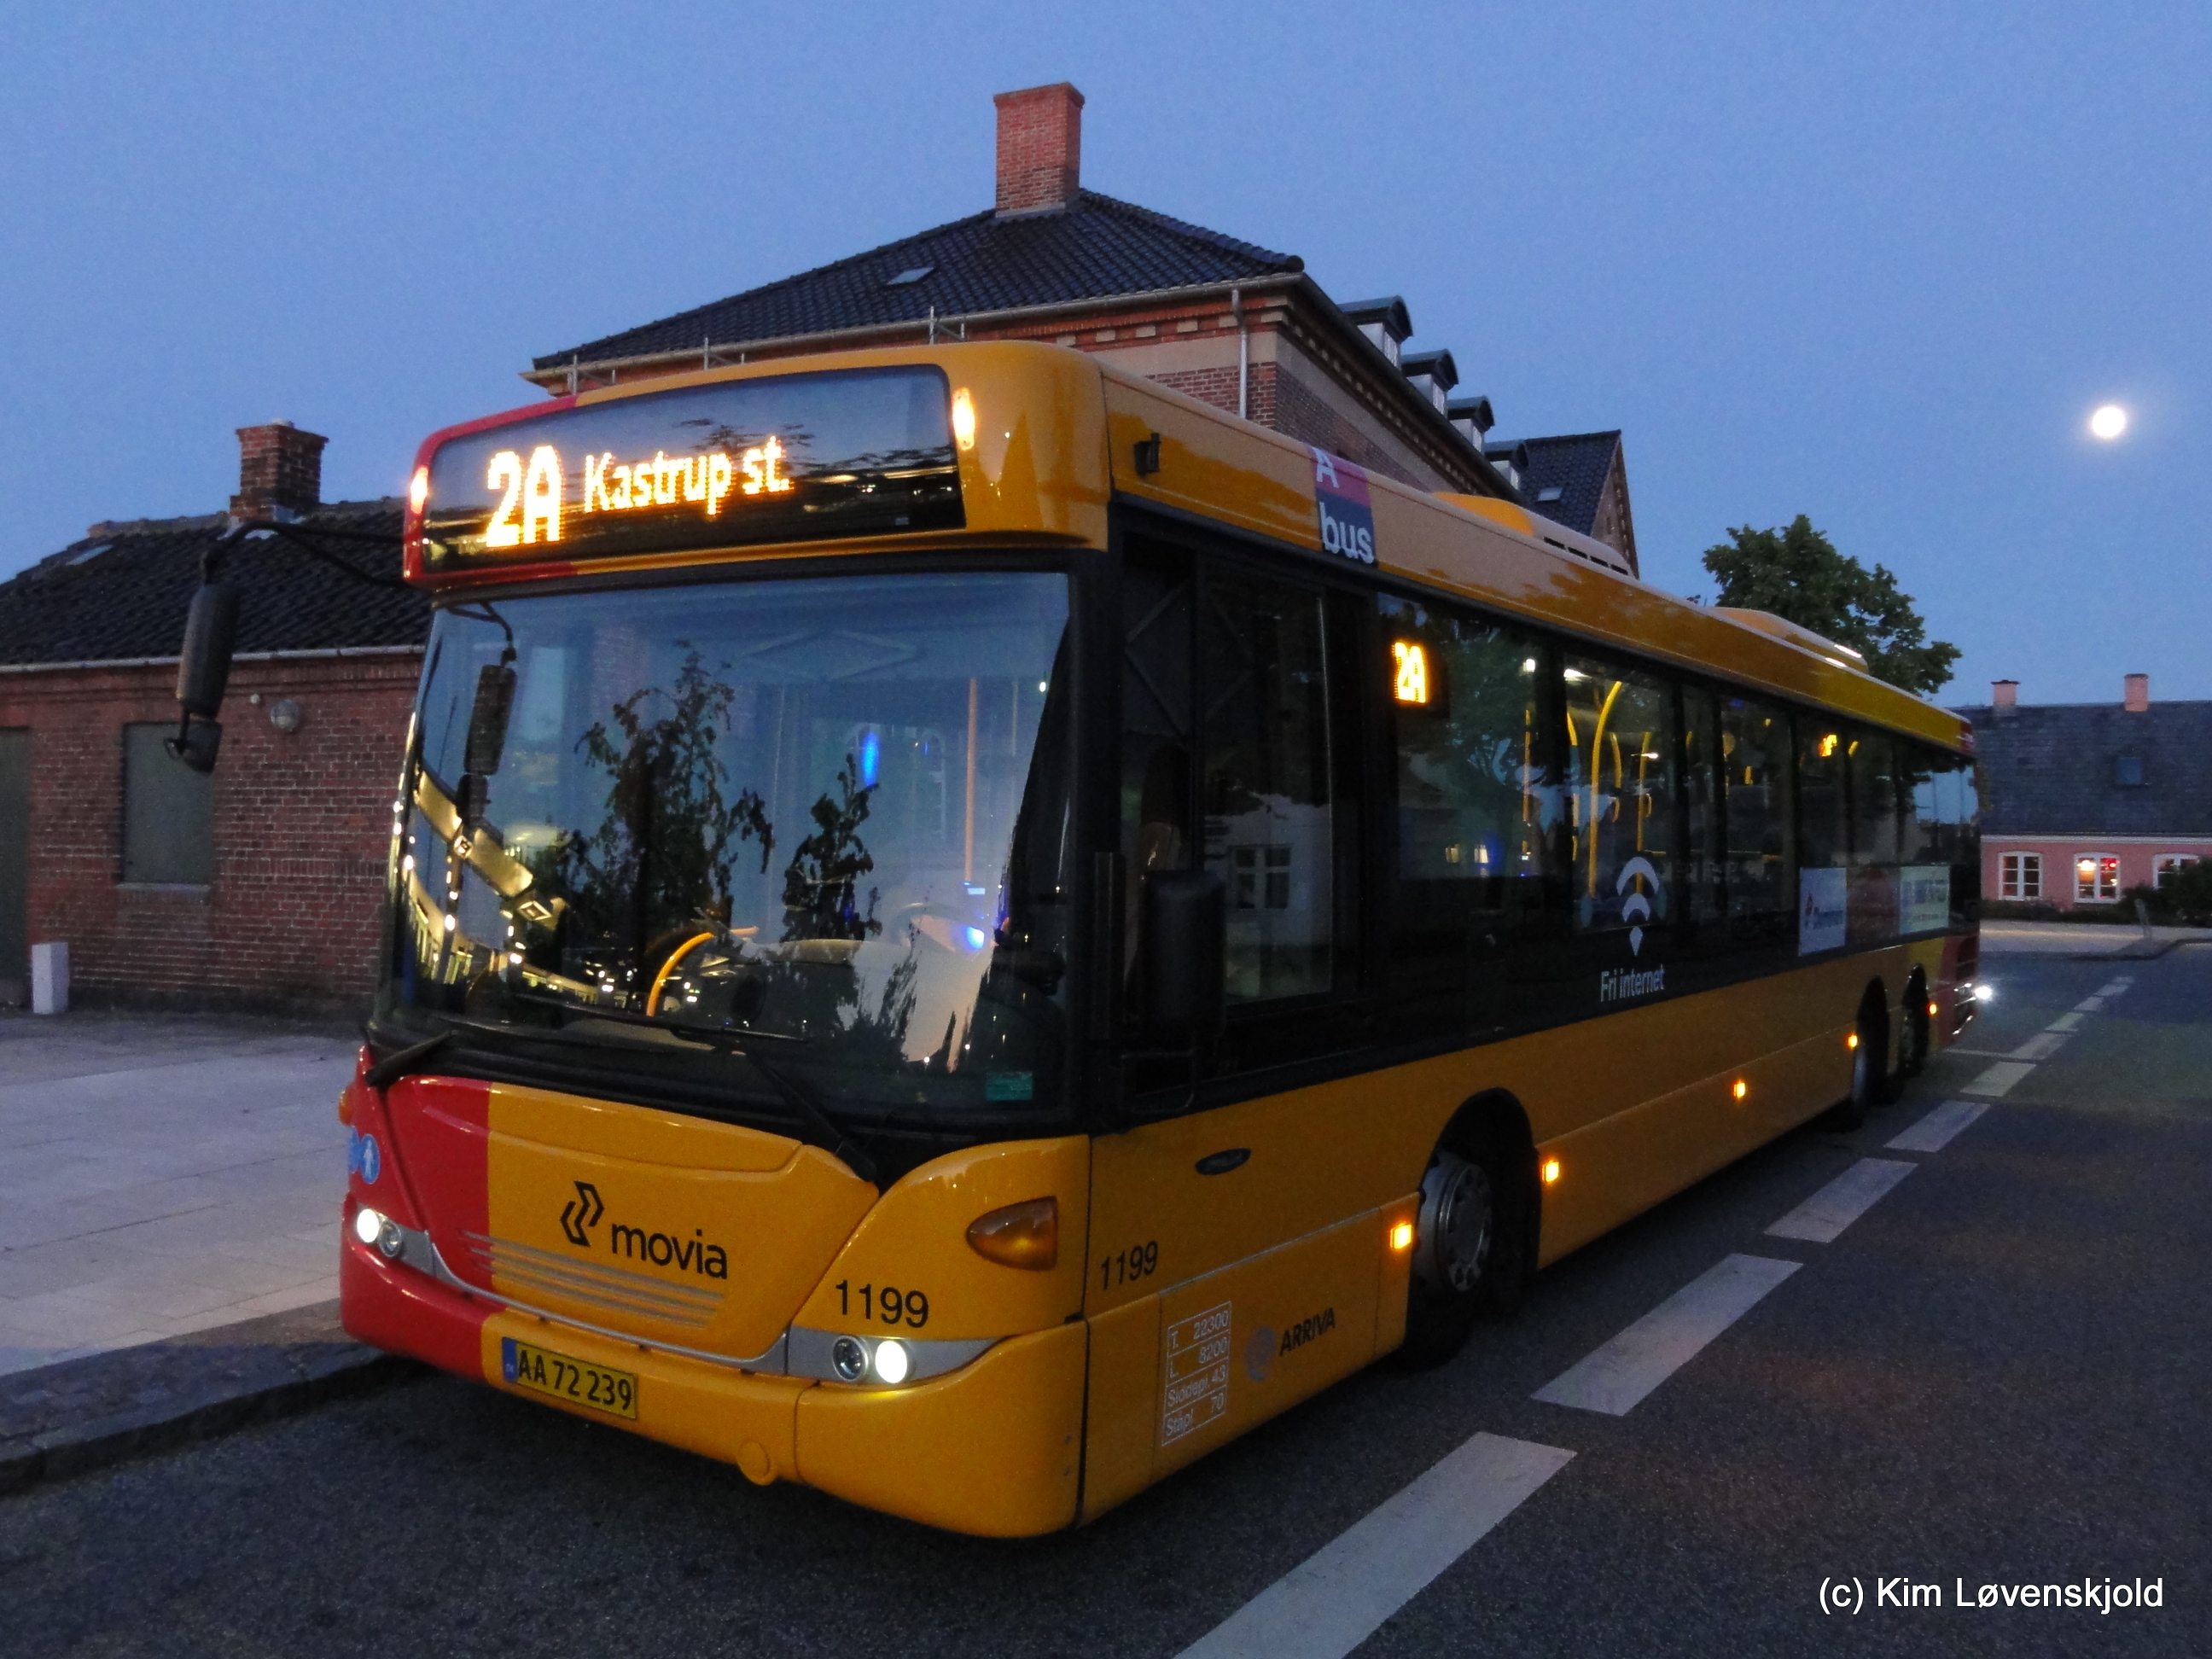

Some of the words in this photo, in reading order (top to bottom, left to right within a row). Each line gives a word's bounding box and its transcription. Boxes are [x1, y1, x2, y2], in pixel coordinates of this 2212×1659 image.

[486, 445, 563, 547] 2A
[584, 451, 732, 515] Kastrup
[742, 435, 792, 496] st.
[1313, 446, 1340, 488] A
[1319, 501, 1376, 565] bus
[1392, 641, 1428, 703] 2A
[1600, 969, 1617, 1002] Fri
[1620, 963, 1665, 998] internet
[610, 1222, 728, 1279] movia
[1101, 1240, 1159, 1291] 1199
[835, 1279, 929, 1329] 1199
[1193, 1310, 1229, 1340] 22300
[1198, 1336, 1228, 1365] 8200
[1279, 1307, 1336, 1357] ARRIVA
[519, 1349, 547, 1385] AA
[553, 1359, 581, 1396] 72
[587, 1370, 632, 1412] 239
[1211, 1365, 1226, 1383] 43
[1210, 1392, 1225, 1414] 70
